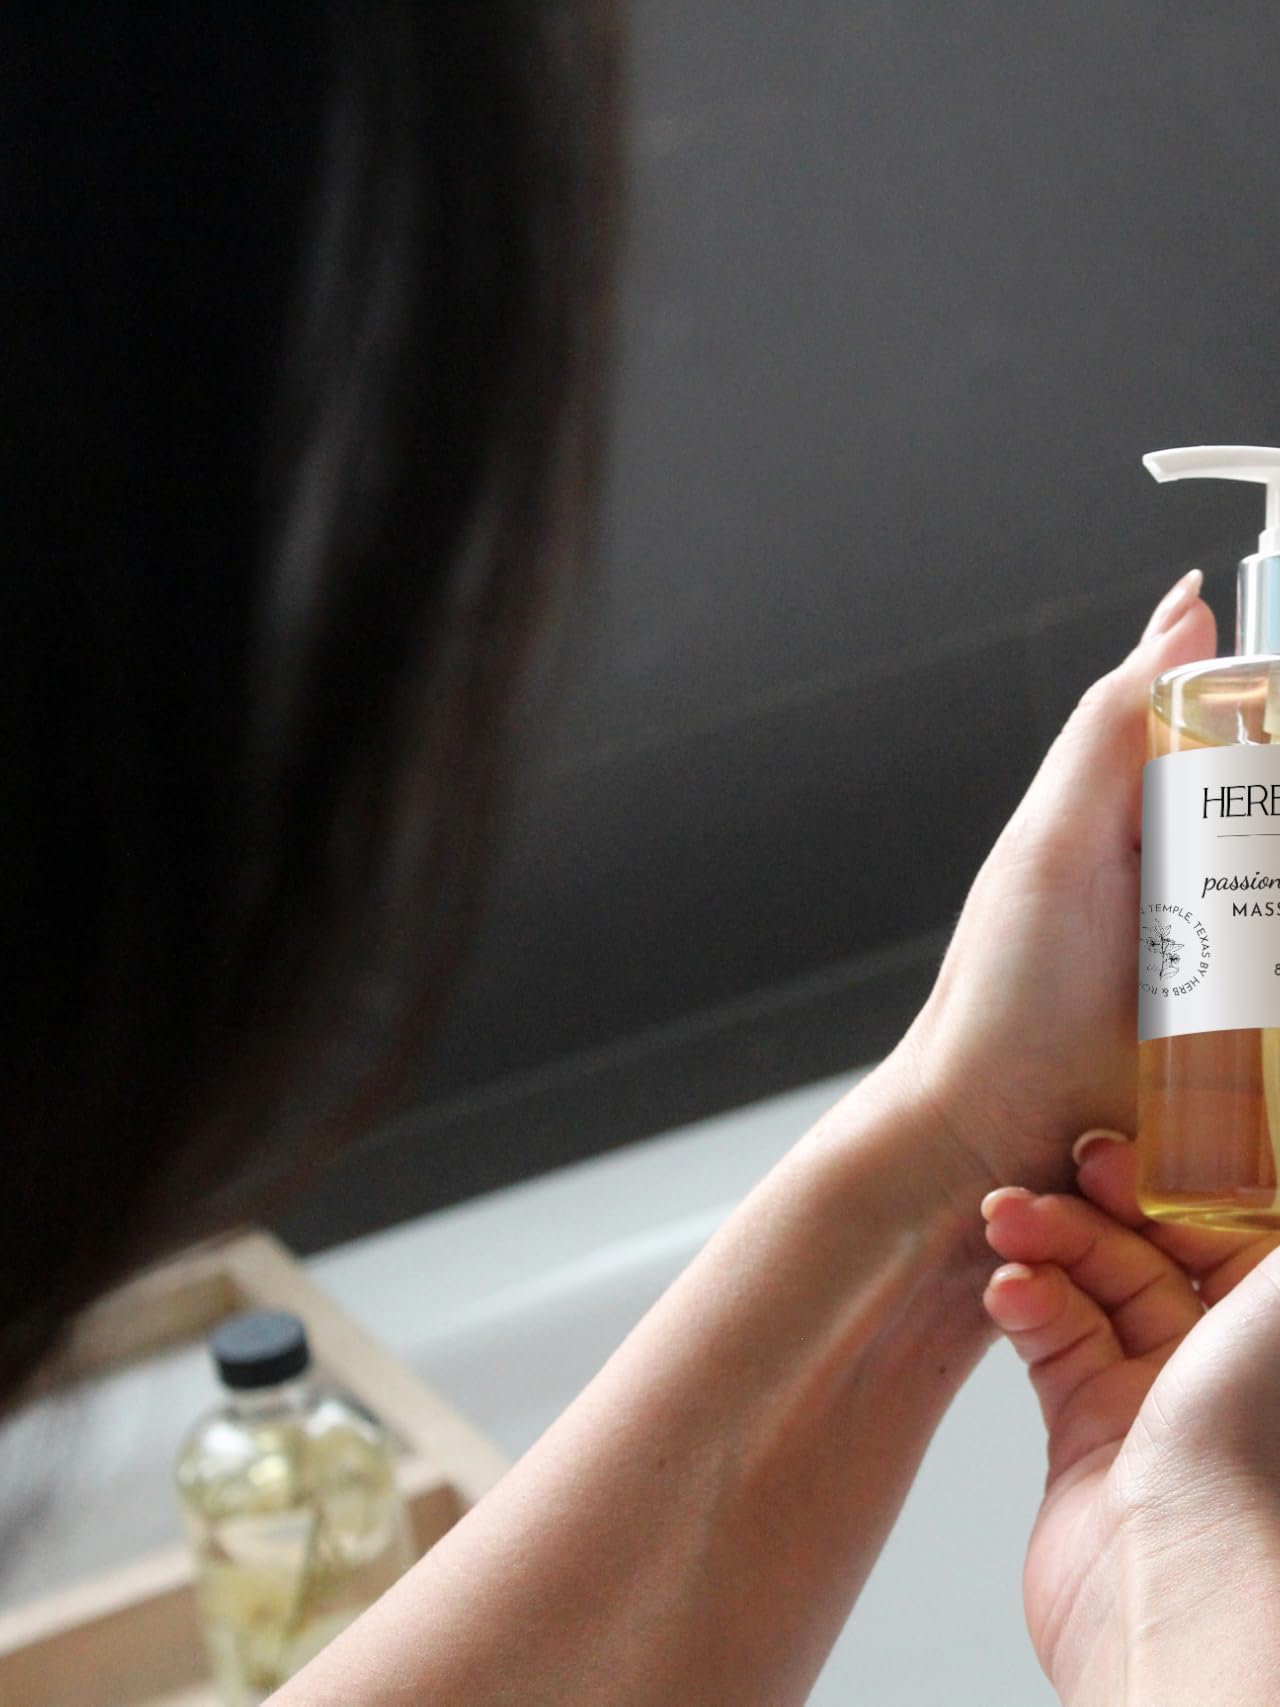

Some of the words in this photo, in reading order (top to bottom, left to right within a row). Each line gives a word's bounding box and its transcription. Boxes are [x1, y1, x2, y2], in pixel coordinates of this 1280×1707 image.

[1148, 903, 1193, 924] TEMPLE,
[1193, 921, 1211, 958] TEXAS
[1198, 961, 1209, 977] BY
[1172, 976, 1200, 996] HERB
